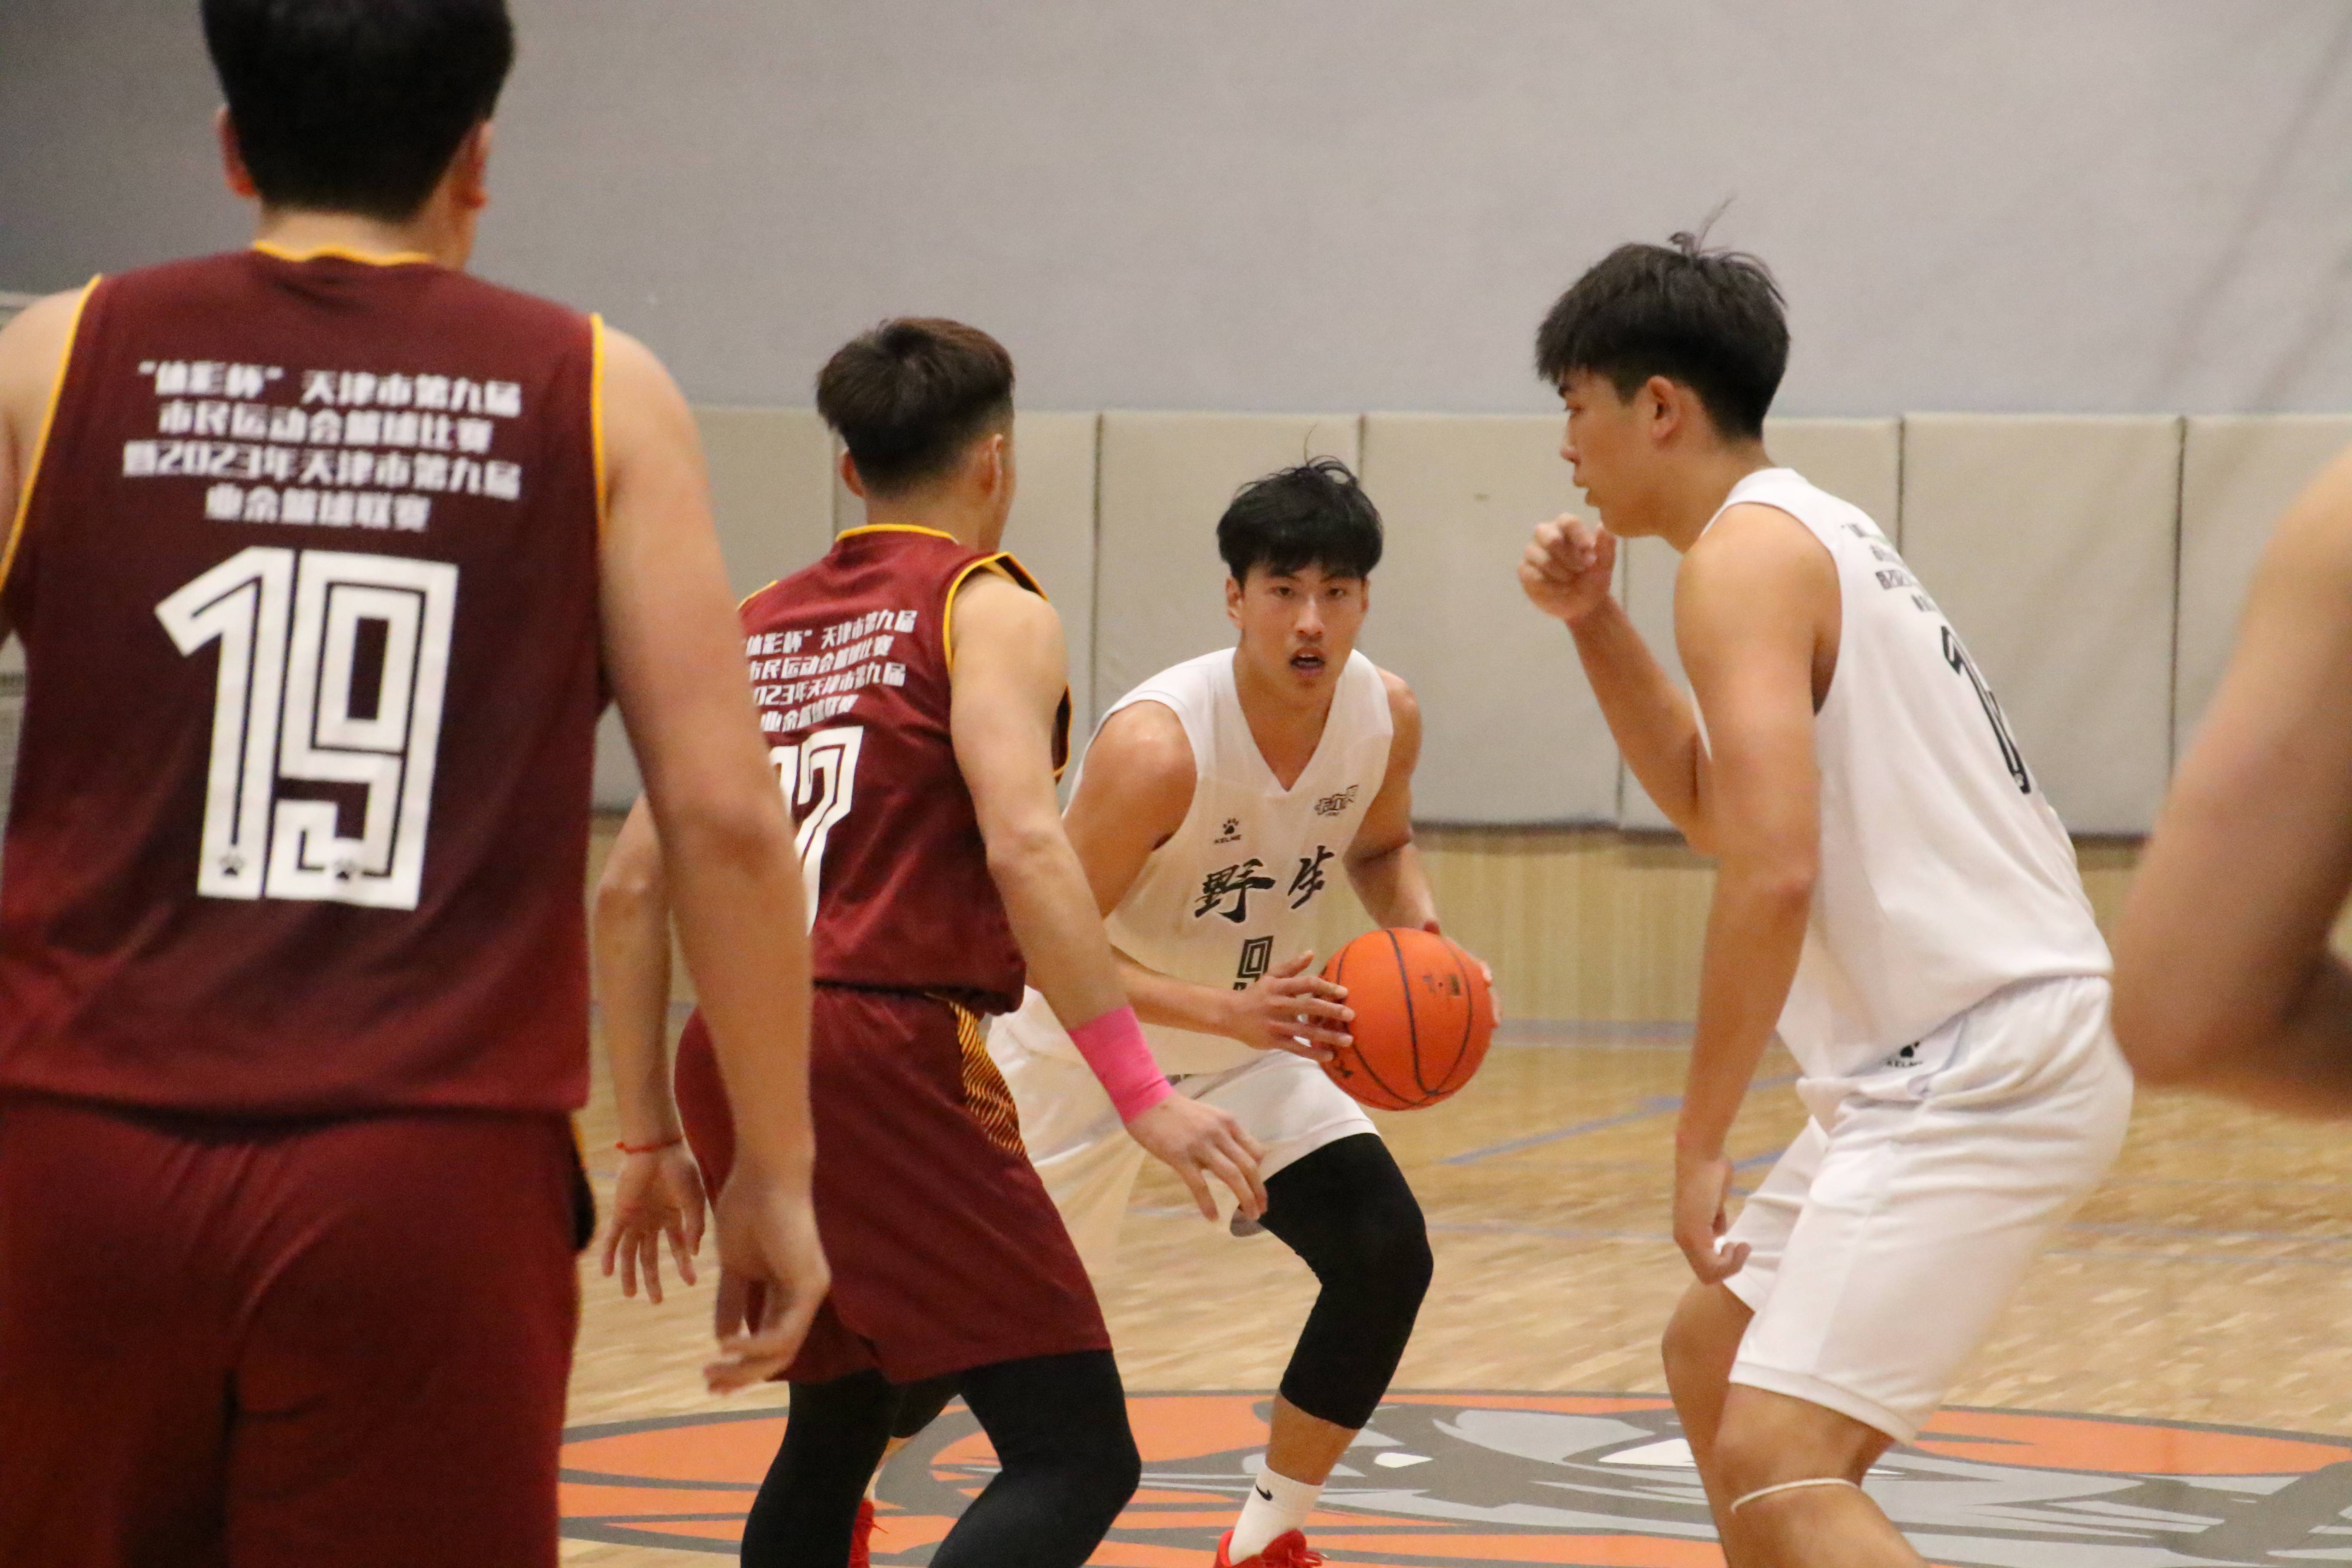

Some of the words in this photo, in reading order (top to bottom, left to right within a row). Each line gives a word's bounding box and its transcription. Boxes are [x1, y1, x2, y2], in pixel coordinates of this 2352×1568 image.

[301, 370, 521, 418] 天津市第九届
[821, 609, 918, 650] 天津市第九届
[154, 545, 459, 911] 19
